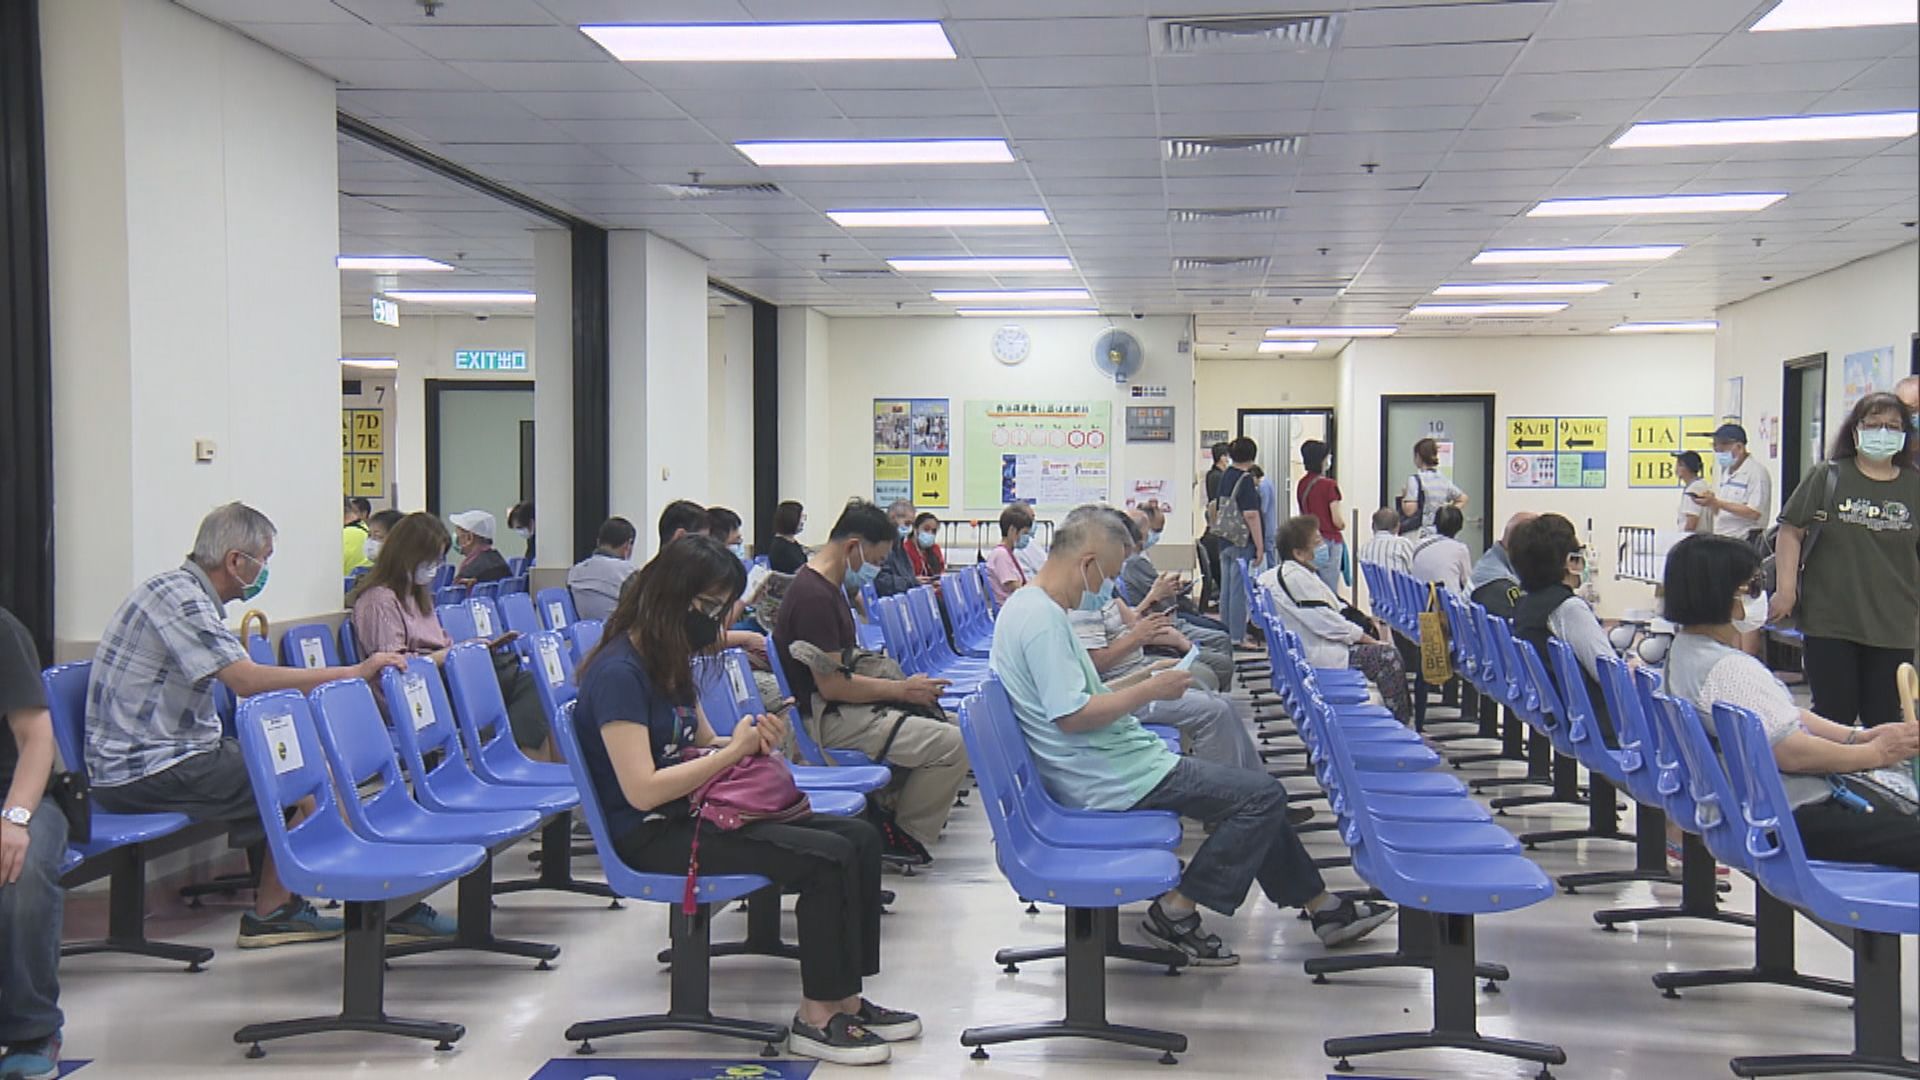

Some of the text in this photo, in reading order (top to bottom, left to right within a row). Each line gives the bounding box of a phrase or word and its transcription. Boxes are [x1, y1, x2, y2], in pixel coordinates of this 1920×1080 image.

[375, 386, 385, 404] 7
[356, 414, 379, 429] 7D
[1428, 420, 1444, 433] 10
[357, 434, 379, 449] 7E
[357, 459, 379, 473] 7F
[1636, 462, 1673, 479] 11B
